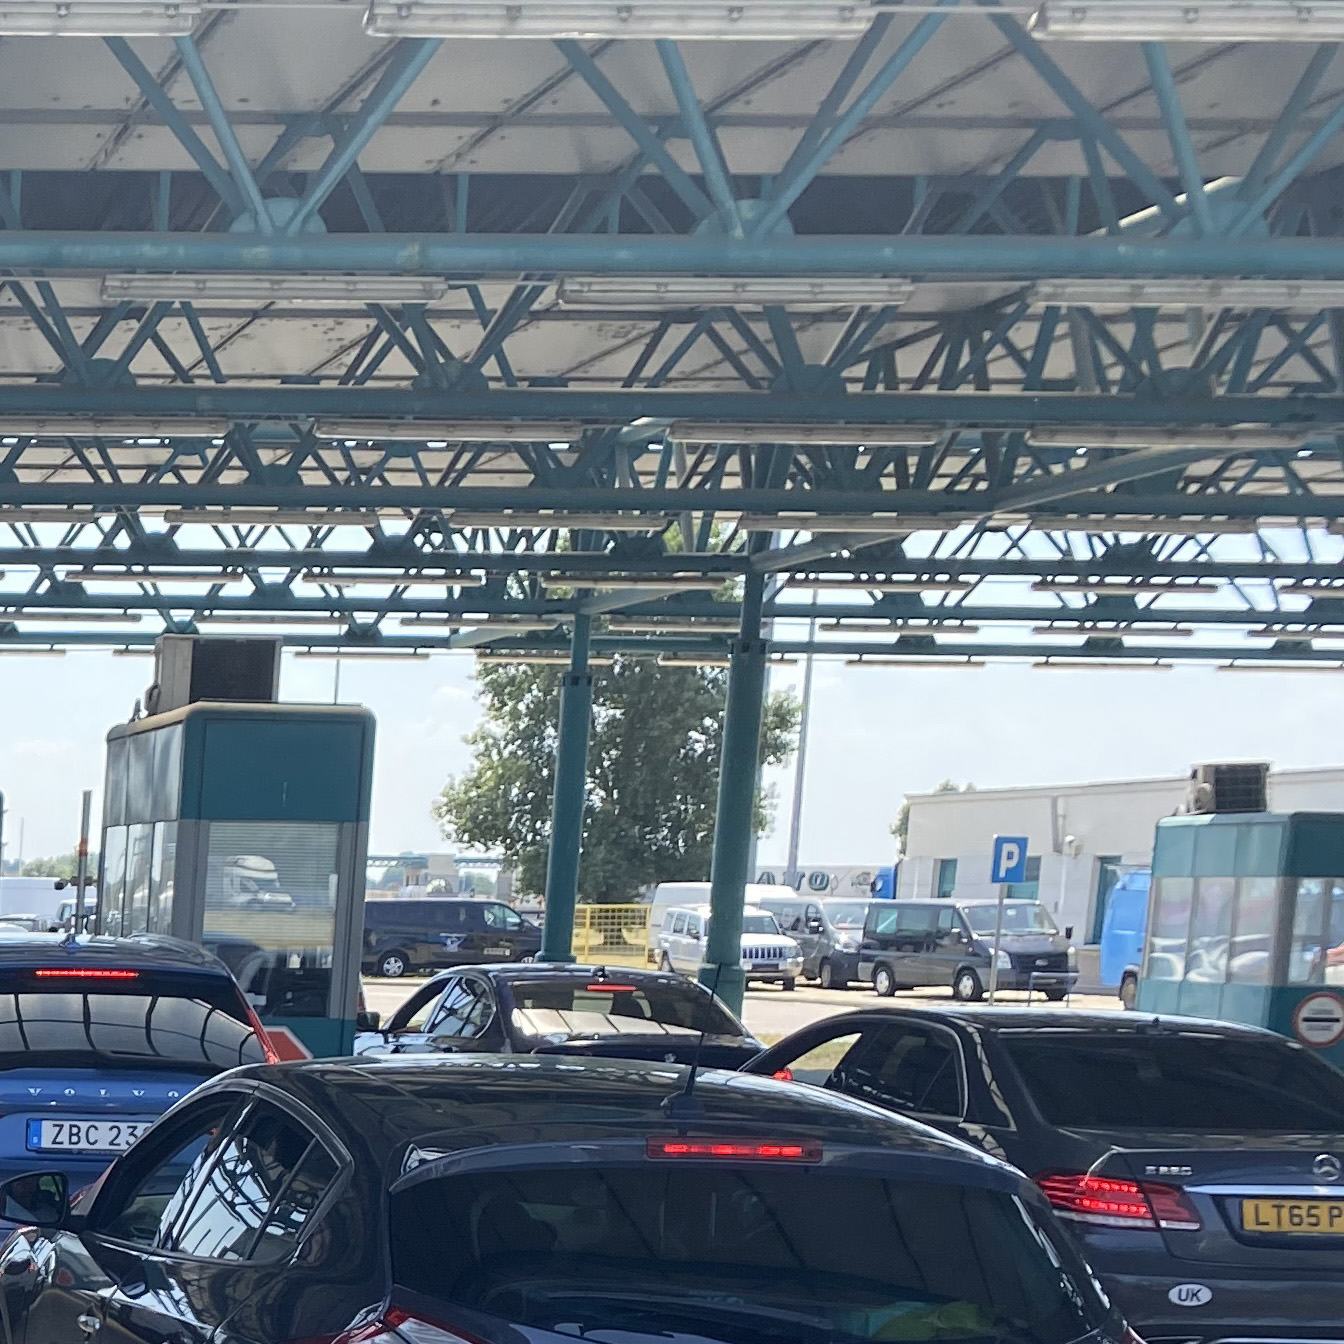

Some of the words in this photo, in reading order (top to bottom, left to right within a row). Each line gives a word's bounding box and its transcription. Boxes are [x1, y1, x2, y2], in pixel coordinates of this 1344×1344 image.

[998, 842, 1020, 878] P
[28, 1087, 179, 1099] VOLVO
[51, 1123, 99, 1146] ZBC
[107, 1124, 153, 1148] 23
[1255, 1203, 1321, 1227] LT65
[1328, 1204, 1343, 1228] P
[1178, 1288, 1202, 1302] UK
